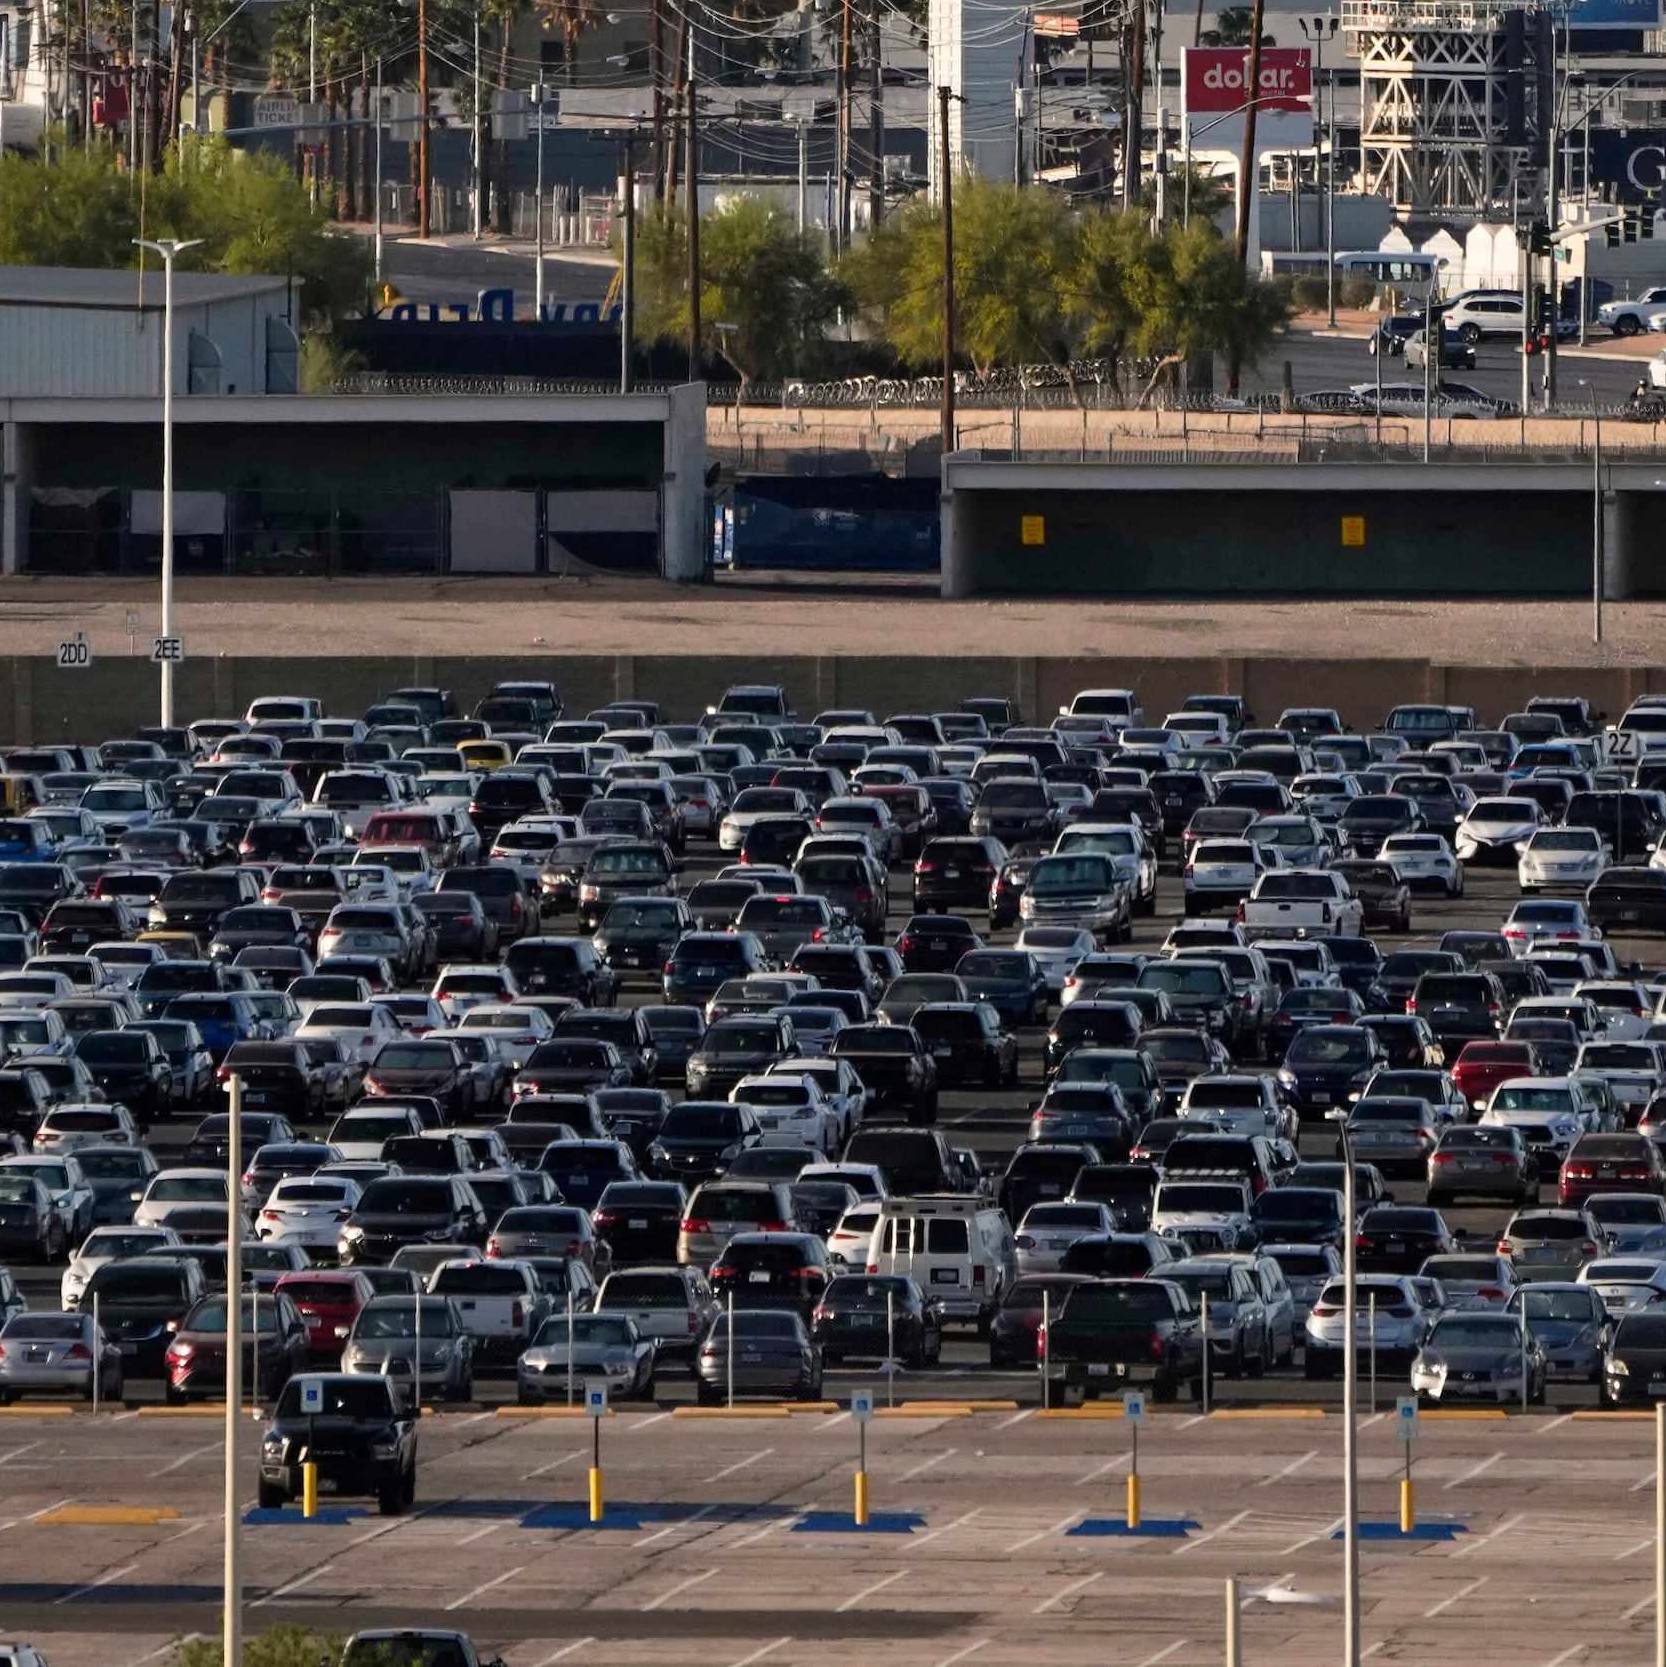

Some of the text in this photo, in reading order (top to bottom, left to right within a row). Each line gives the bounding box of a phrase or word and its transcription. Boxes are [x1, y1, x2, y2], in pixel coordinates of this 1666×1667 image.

[1203, 63, 1295, 89] dolar.
[257, 100, 295, 112] AIRLI
[257, 112, 295, 123] TICKE
[59, 642, 88, 665] 2DD
[154, 639, 181, 660] 2EE
[1608, 732, 1632, 756] 2Z
